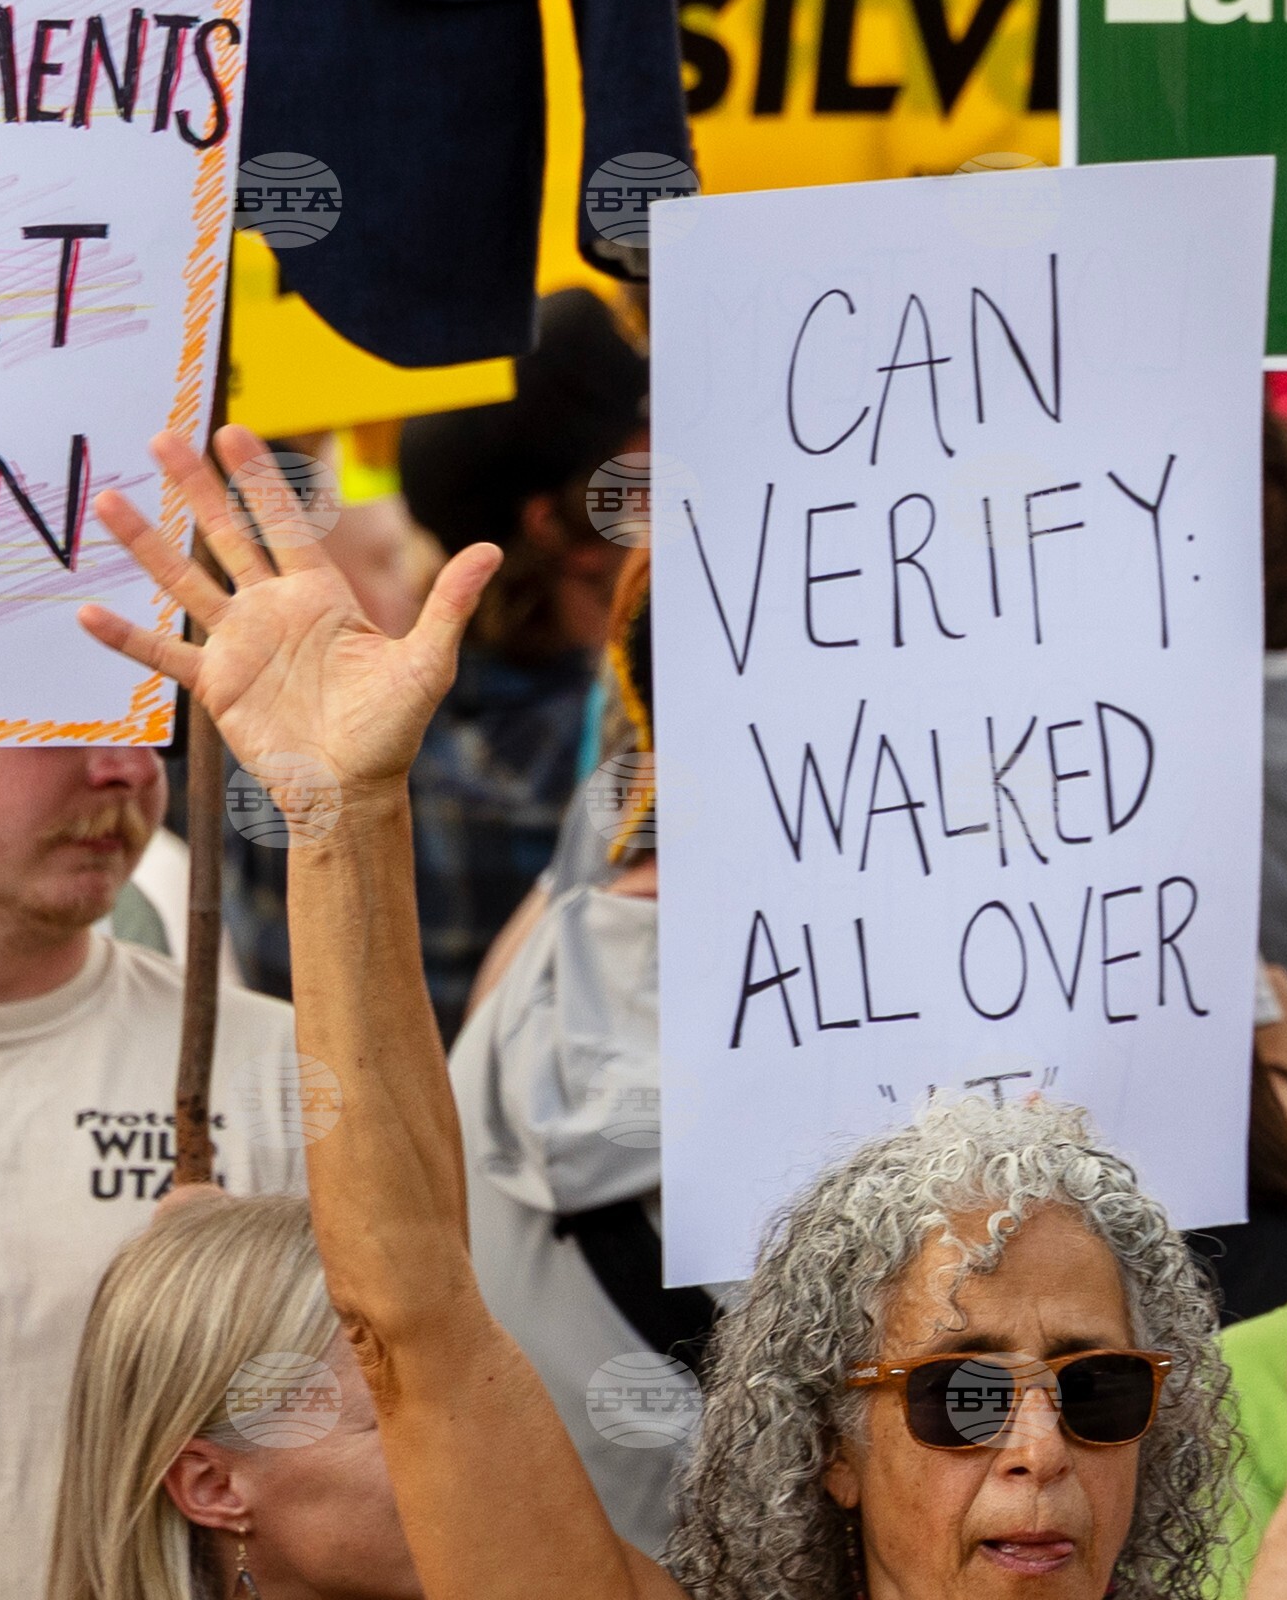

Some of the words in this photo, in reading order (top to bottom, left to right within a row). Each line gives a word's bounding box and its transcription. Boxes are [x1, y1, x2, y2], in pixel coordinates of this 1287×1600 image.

[785, 252, 1062, 467] CAN
[682, 453, 1203, 677] VERIFY:
[748, 697, 1157, 877] WALKED
[727, 908, 922, 1050] ALL
[958, 874, 1211, 1025] OVER
[75, 1110, 227, 1130] Protet
